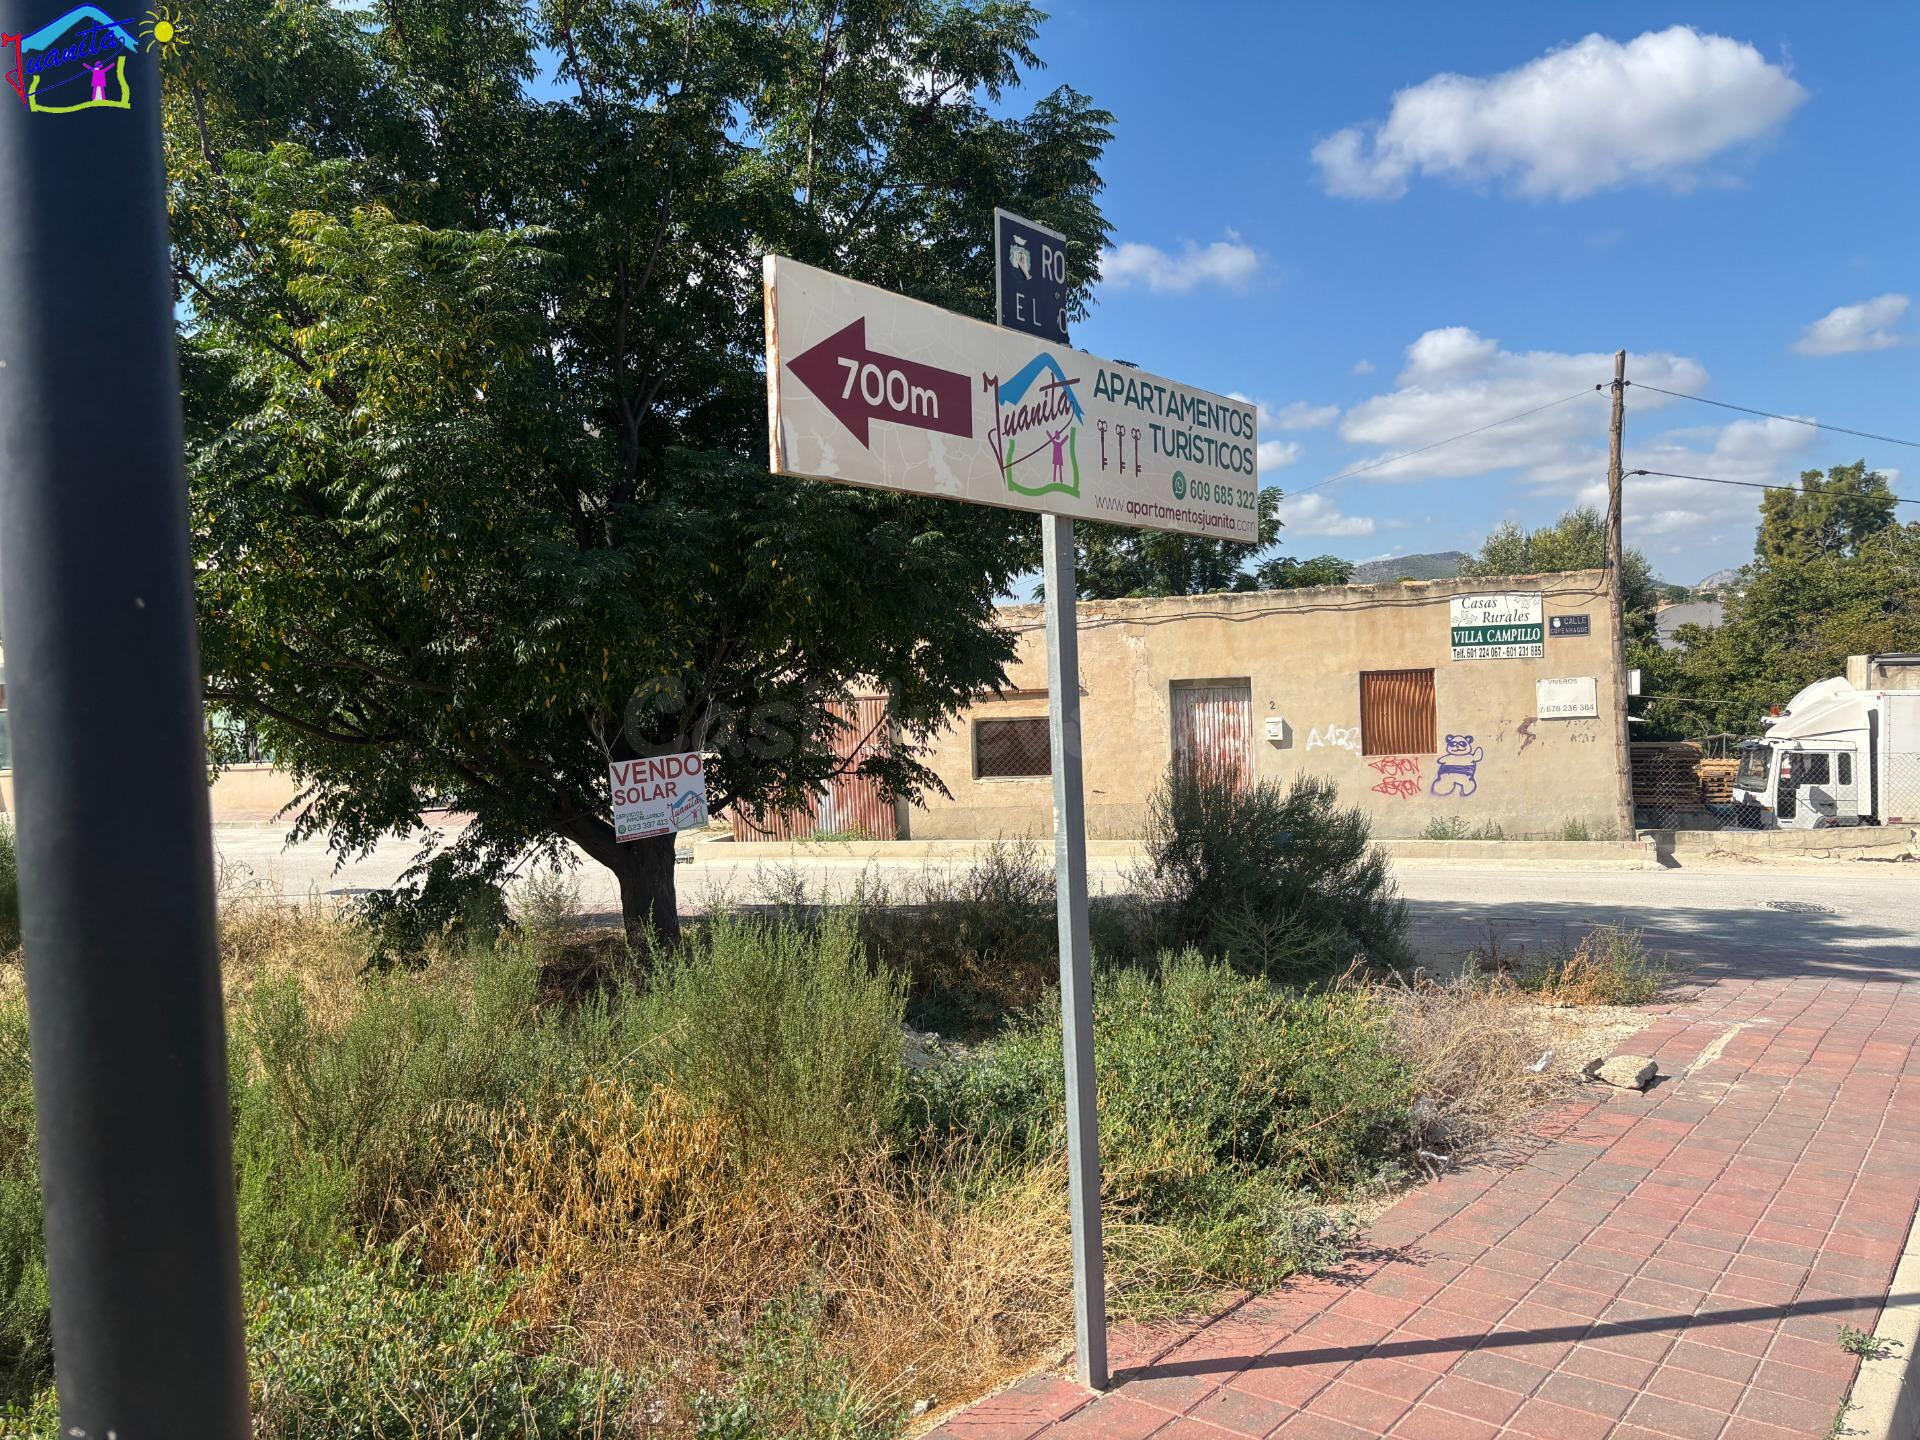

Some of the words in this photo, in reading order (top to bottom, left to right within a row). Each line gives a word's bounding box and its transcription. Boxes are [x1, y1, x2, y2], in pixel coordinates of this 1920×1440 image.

[838, 356, 939, 419] 700m
[1093, 368, 1254, 440] APARTAMENTOS
[1149, 422, 1254, 476] TURÍSTICOS
[1190, 479, 1211, 502] 609
[1214, 484, 1234, 506] 685
[1236, 489, 1255, 510] 322
[1095, 495, 1256, 533] www.apartamentosjuanita.com
[1461, 596, 1498, 610] Casas
[1482, 608, 1530, 624] Rurales
[1563, 616, 1588, 625] CALLE
[1453, 630, 1484, 644] VILLA
[1486, 627, 1541, 643] CAMPILLO
[1269, 700, 1277, 710] 2
[611, 754, 702, 786] VENDO
[614, 781, 678, 806] SOLAR
